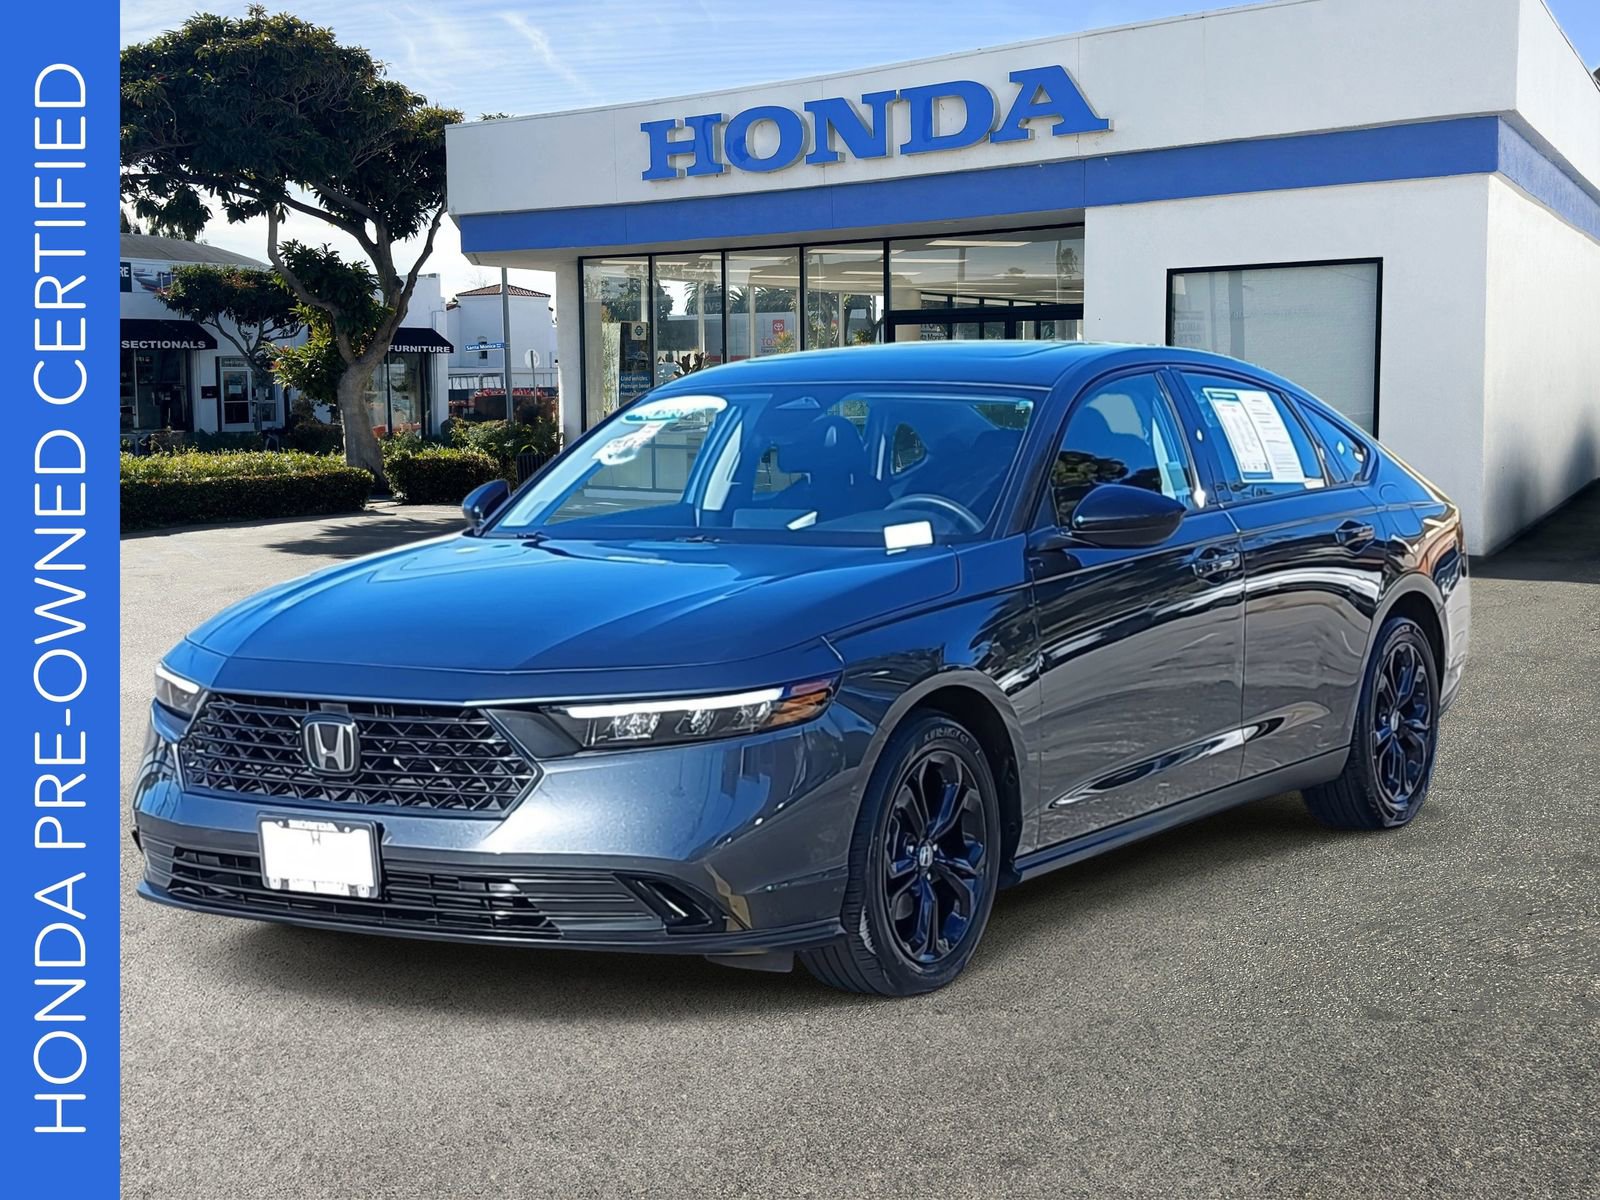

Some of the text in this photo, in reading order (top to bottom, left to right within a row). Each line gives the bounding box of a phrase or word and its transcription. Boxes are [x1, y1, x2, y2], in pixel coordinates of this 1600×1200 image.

[641, 64, 1111, 181] HONDA
[121, 340, 206, 349] SECTIONALS
[388, 345, 450, 353] FURNITURE
